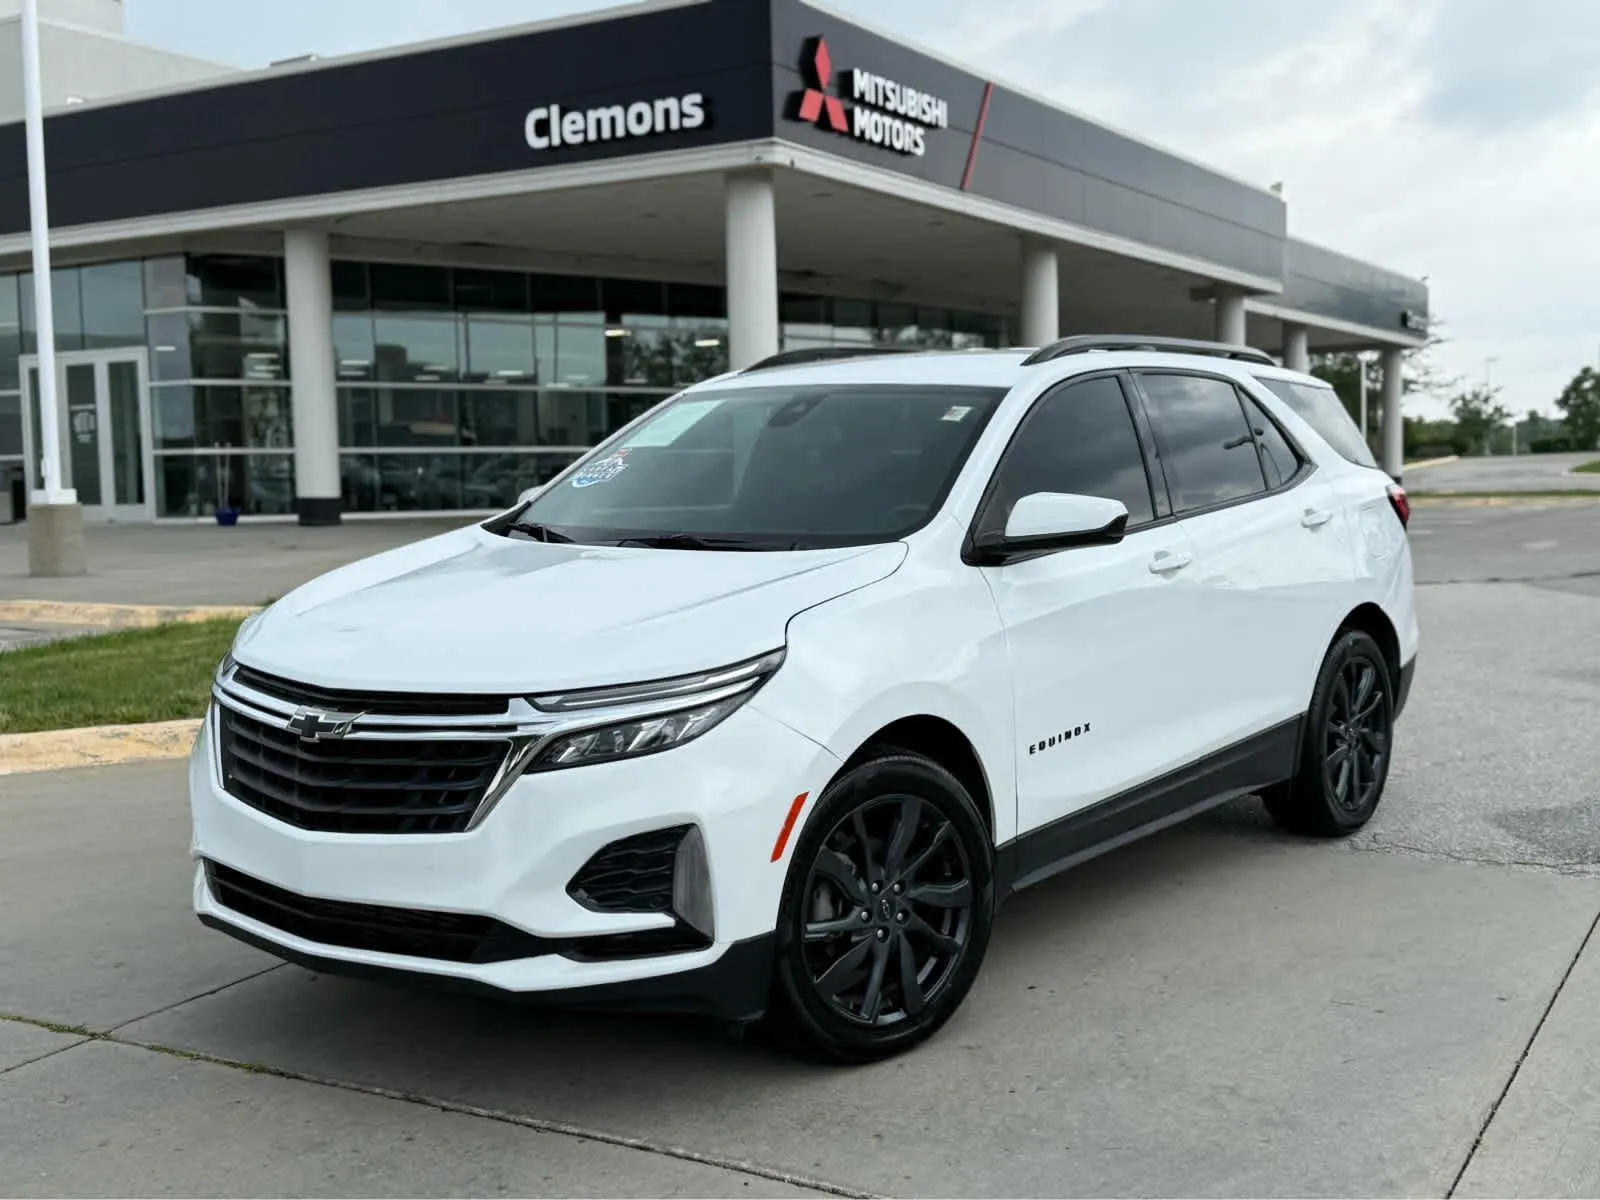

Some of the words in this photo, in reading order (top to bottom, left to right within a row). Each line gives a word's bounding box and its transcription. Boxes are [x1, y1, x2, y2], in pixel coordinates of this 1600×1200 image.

[525, 93, 705, 149] Clemons
[853, 67, 948, 129] MITSUBISHI
[854, 105, 925, 156] MOTORS
[1029, 722, 1090, 755] EQUINOX
